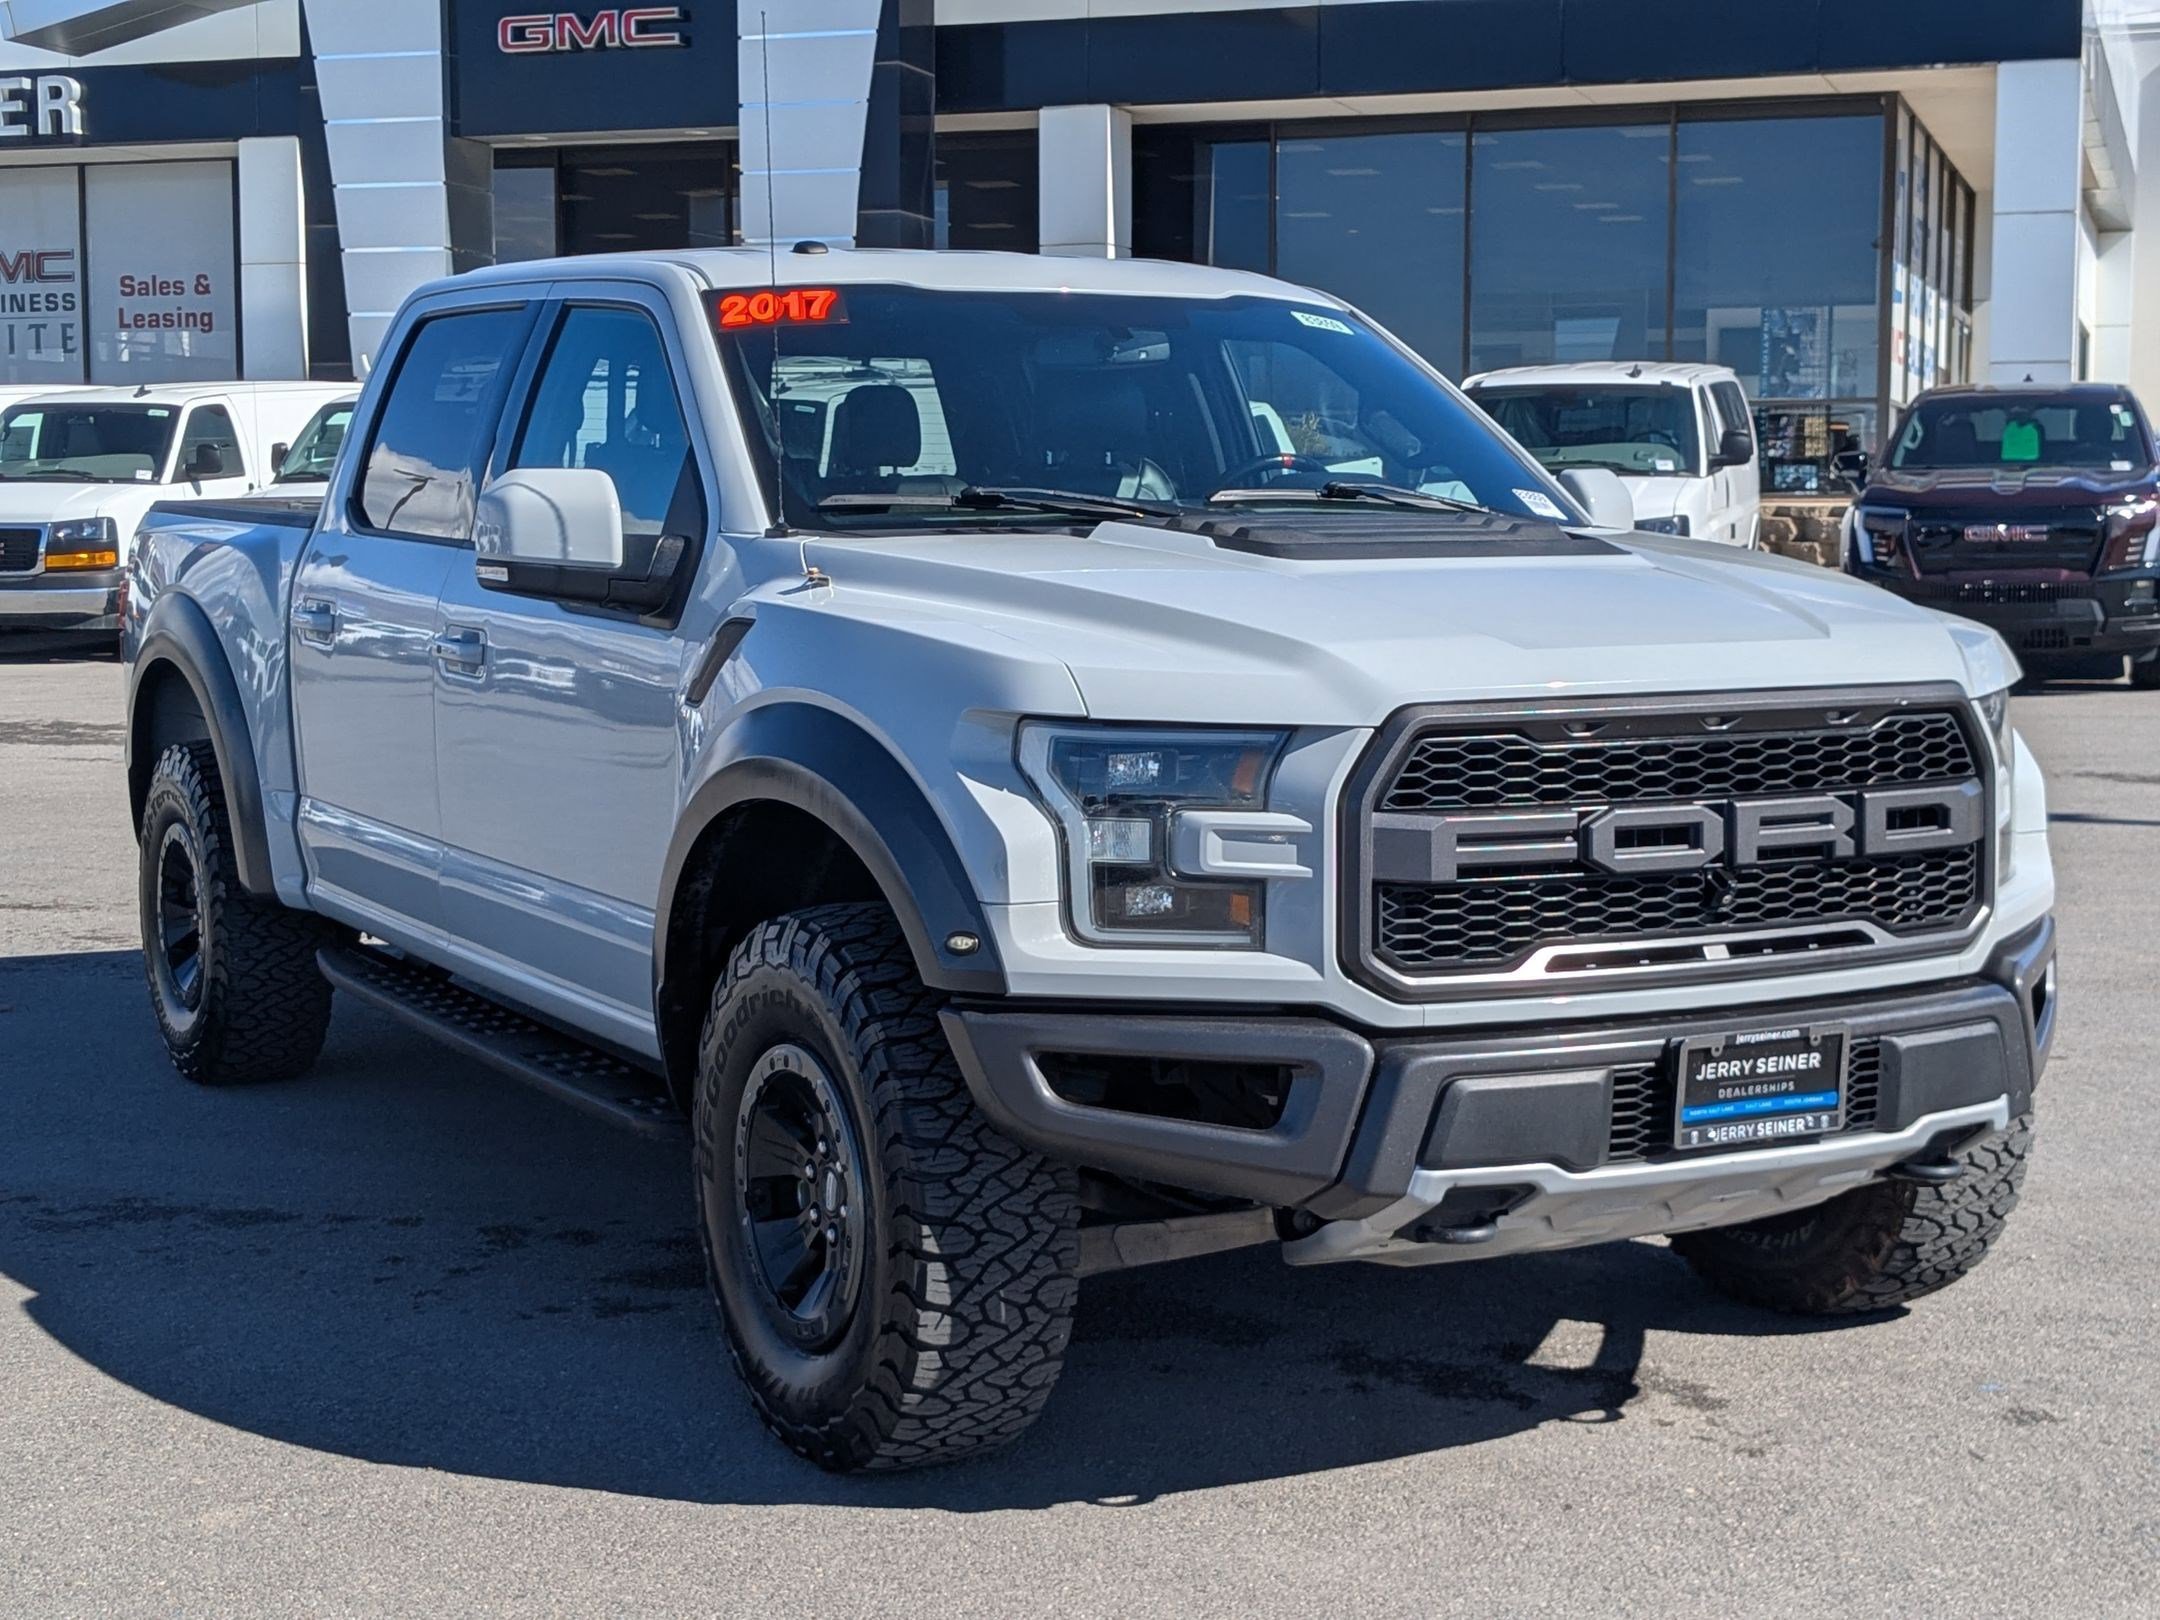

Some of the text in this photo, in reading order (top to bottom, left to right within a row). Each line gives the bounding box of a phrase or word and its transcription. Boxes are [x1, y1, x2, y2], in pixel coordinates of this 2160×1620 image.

[498, 6, 681, 53] GMC
[119, 273, 211, 297] Sales &
[118, 306, 213, 333] Leasing
[720, 290, 837, 326] 2017
[1374, 777, 1984, 885] FORD
[1695, 1052, 1822, 1081] JERRY SEINER
[1718, 1081, 1795, 1099] DEALERSHIPS
[1714, 1118, 1805, 1142] JERRY SEINER
